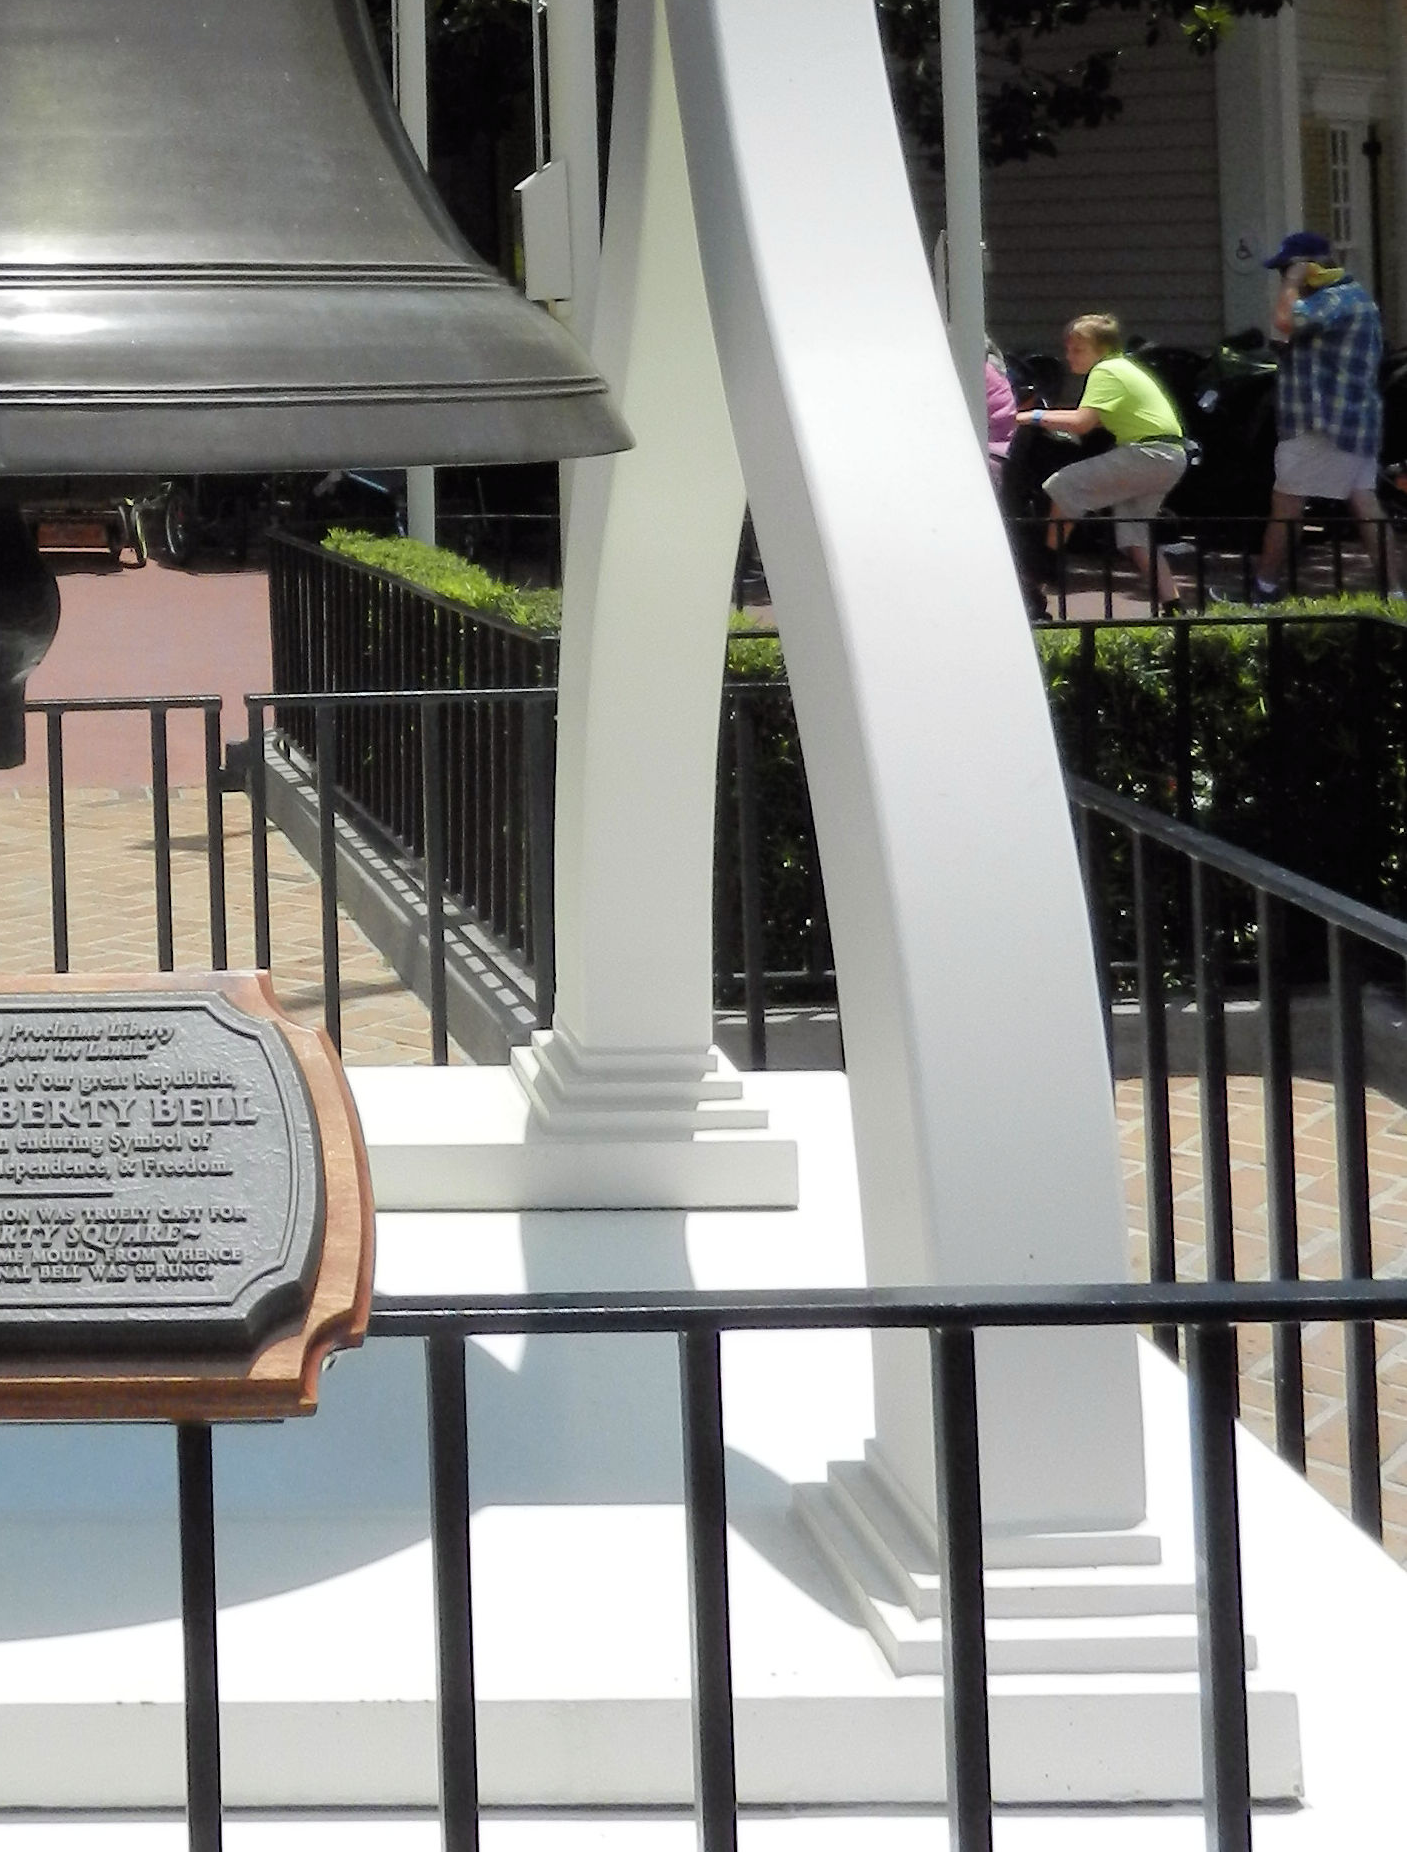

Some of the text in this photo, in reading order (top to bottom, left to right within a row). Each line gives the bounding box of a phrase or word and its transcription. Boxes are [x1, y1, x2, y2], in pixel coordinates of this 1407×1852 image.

[107, 1020, 174, 1045] Liberty
[53, 1042, 80, 1060] the
[14, 1072, 38, 1091] of
[40, 1075, 74, 1091] our
[79, 1073, 129, 1096] great
[150, 1096, 259, 1127] BELL
[15, 1132, 104, 1158] enduring
[109, 1130, 183, 1157] Symbol
[188, 1130, 213, 1152] of
[117, 1158, 137, 1178] &
[143, 1157, 234, 1179] Freedom.
[36, 1207, 76, 1225] WAS
[82, 1206, 151, 1225] TRUELY
[156, 1204, 203, 1224] CAST
[208, 1204, 247, 1223] FOR
[30, 1248, 97, 1266] MOULD
[104, 1248, 157, 1266] FROM
[163, 1247, 243, 1266] WHENCE
[38, 1264, 83, 1283] BELL
[87, 1264, 129, 1283] WAS
[134, 1262, 214, 1283] SPRUNG.
